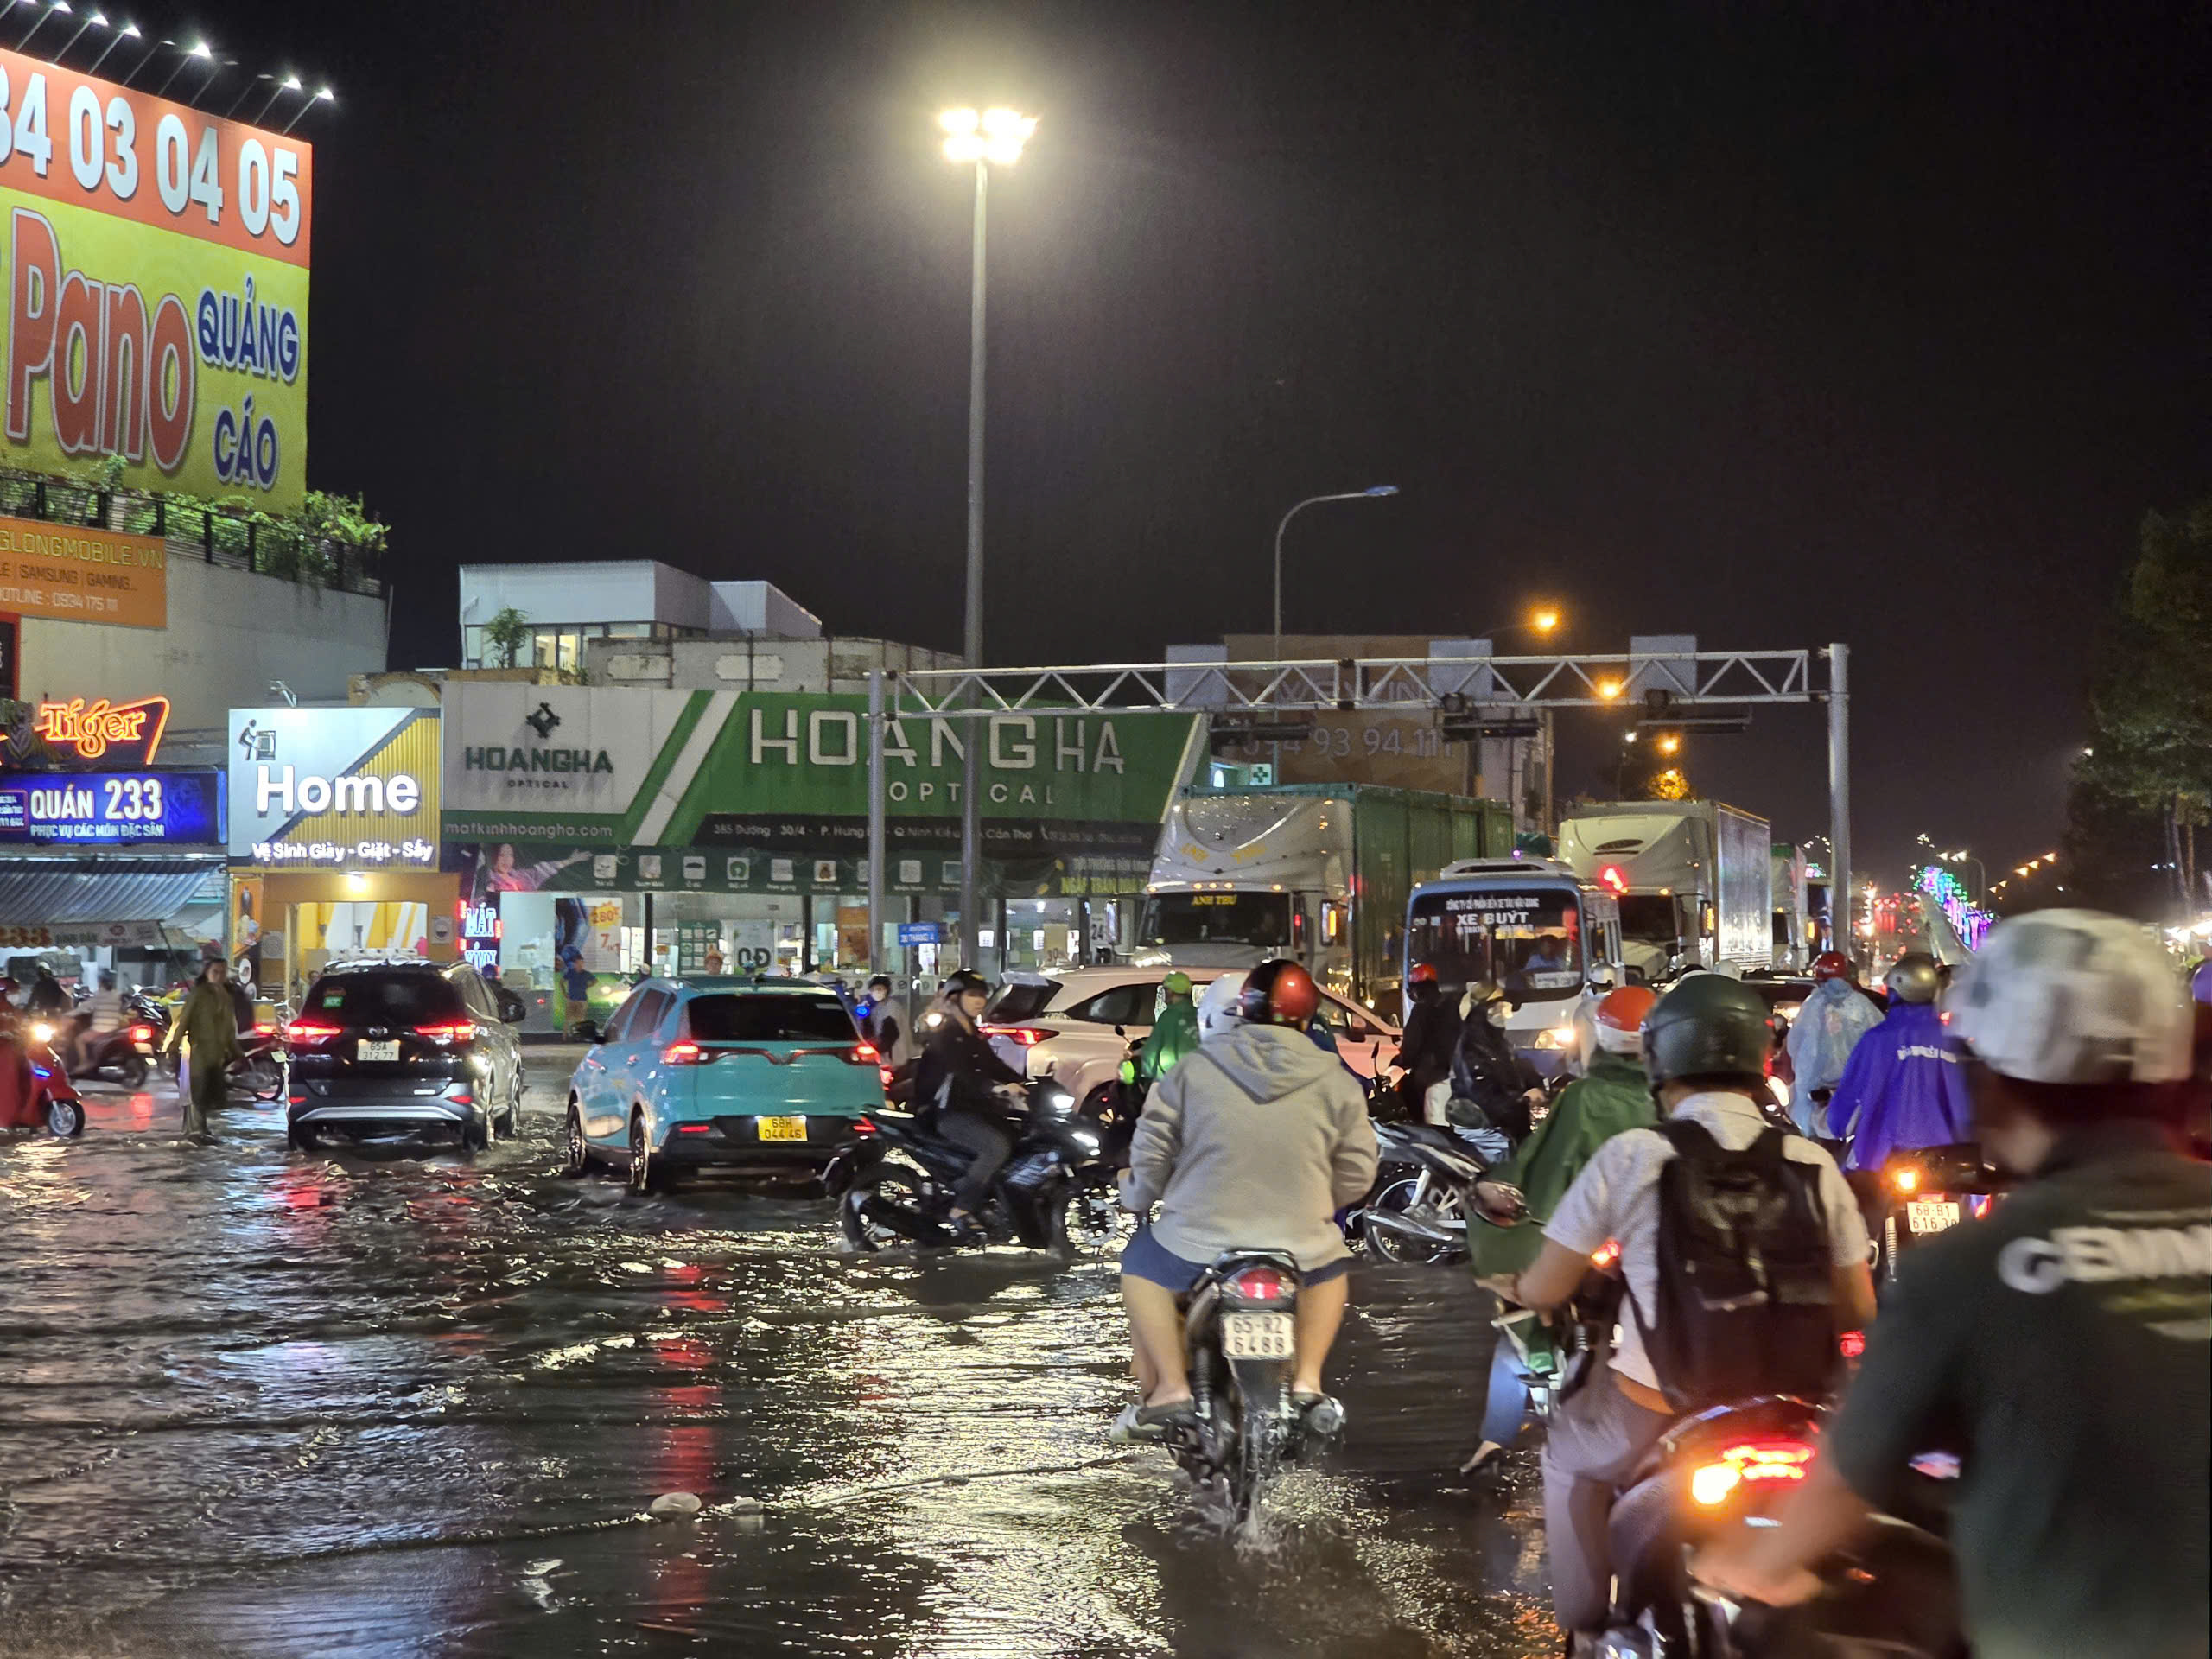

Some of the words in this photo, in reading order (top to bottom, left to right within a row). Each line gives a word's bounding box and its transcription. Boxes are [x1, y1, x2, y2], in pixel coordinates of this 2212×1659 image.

[70, 86, 137, 198] 03
[157, 114, 223, 222] 04
[239, 139, 300, 244] 05
[7, 207, 195, 471] Pano
[198, 273, 299, 382] QUẢNG
[213, 393, 279, 489] CÁO
[40, 697, 147, 759] Tiger
[1363, 728, 1404, 756] 94
[465, 746, 614, 774] HOANGHA
[30, 782, 94, 819] QUÁN
[105, 779, 162, 820] 233
[257, 765, 420, 813] Home
[507, 779, 569, 789] OPTICAL
[889, 781, 1054, 804] OPTCAL
[273, 842, 308, 859] Sinh
[309, 842, 345, 863] Giày
[358, 842, 391, 861] Giặt
[1456, 913, 1478, 926] XE
[1483, 910, 1529, 925] BUÝT
